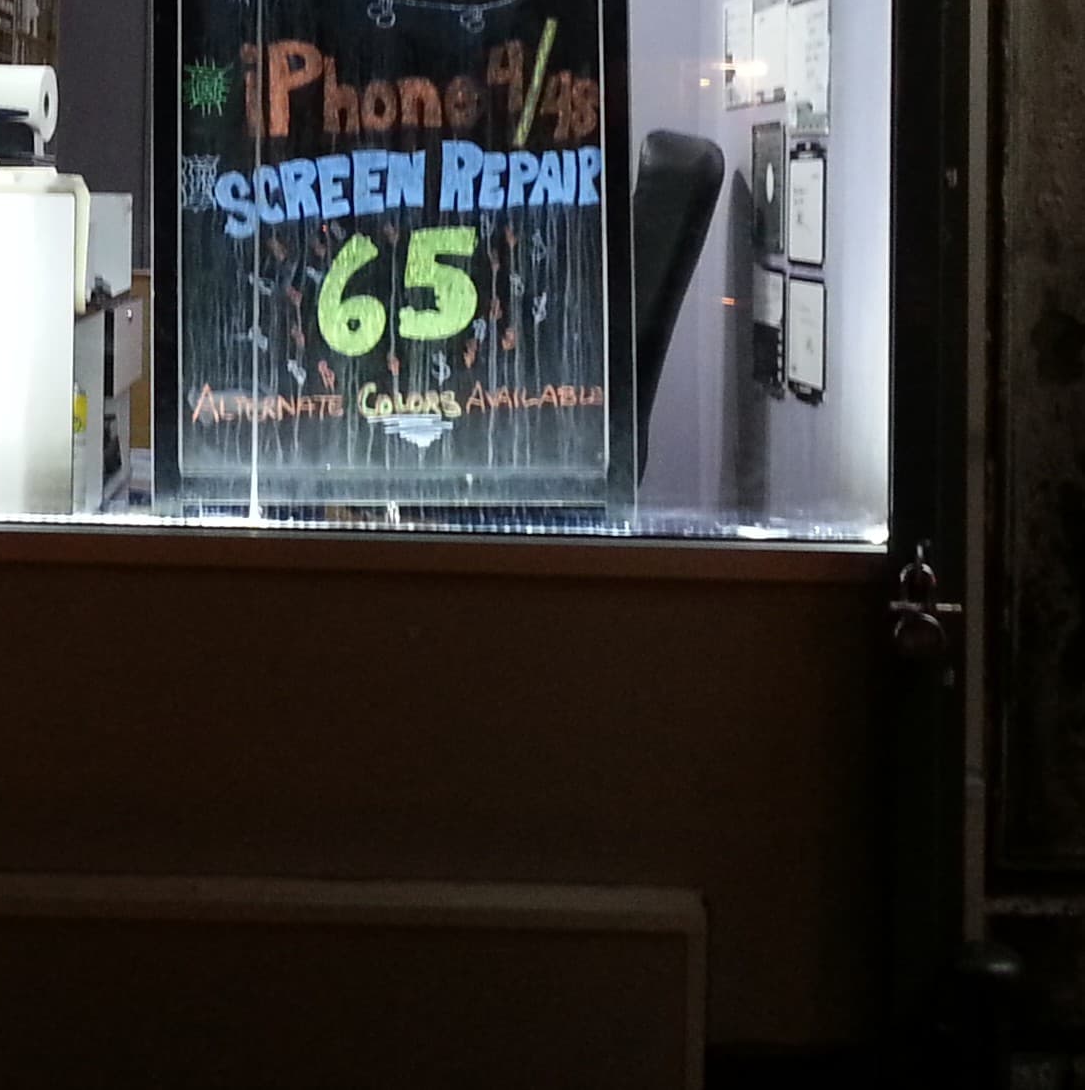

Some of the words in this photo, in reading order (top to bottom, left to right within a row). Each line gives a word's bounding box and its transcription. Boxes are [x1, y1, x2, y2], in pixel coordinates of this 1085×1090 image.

[240, 39, 479, 138] iPhone
[215, 149, 426, 239] SCREEN
[439, 139, 602, 211] REPAIR
[317, 226, 478, 357] 65
